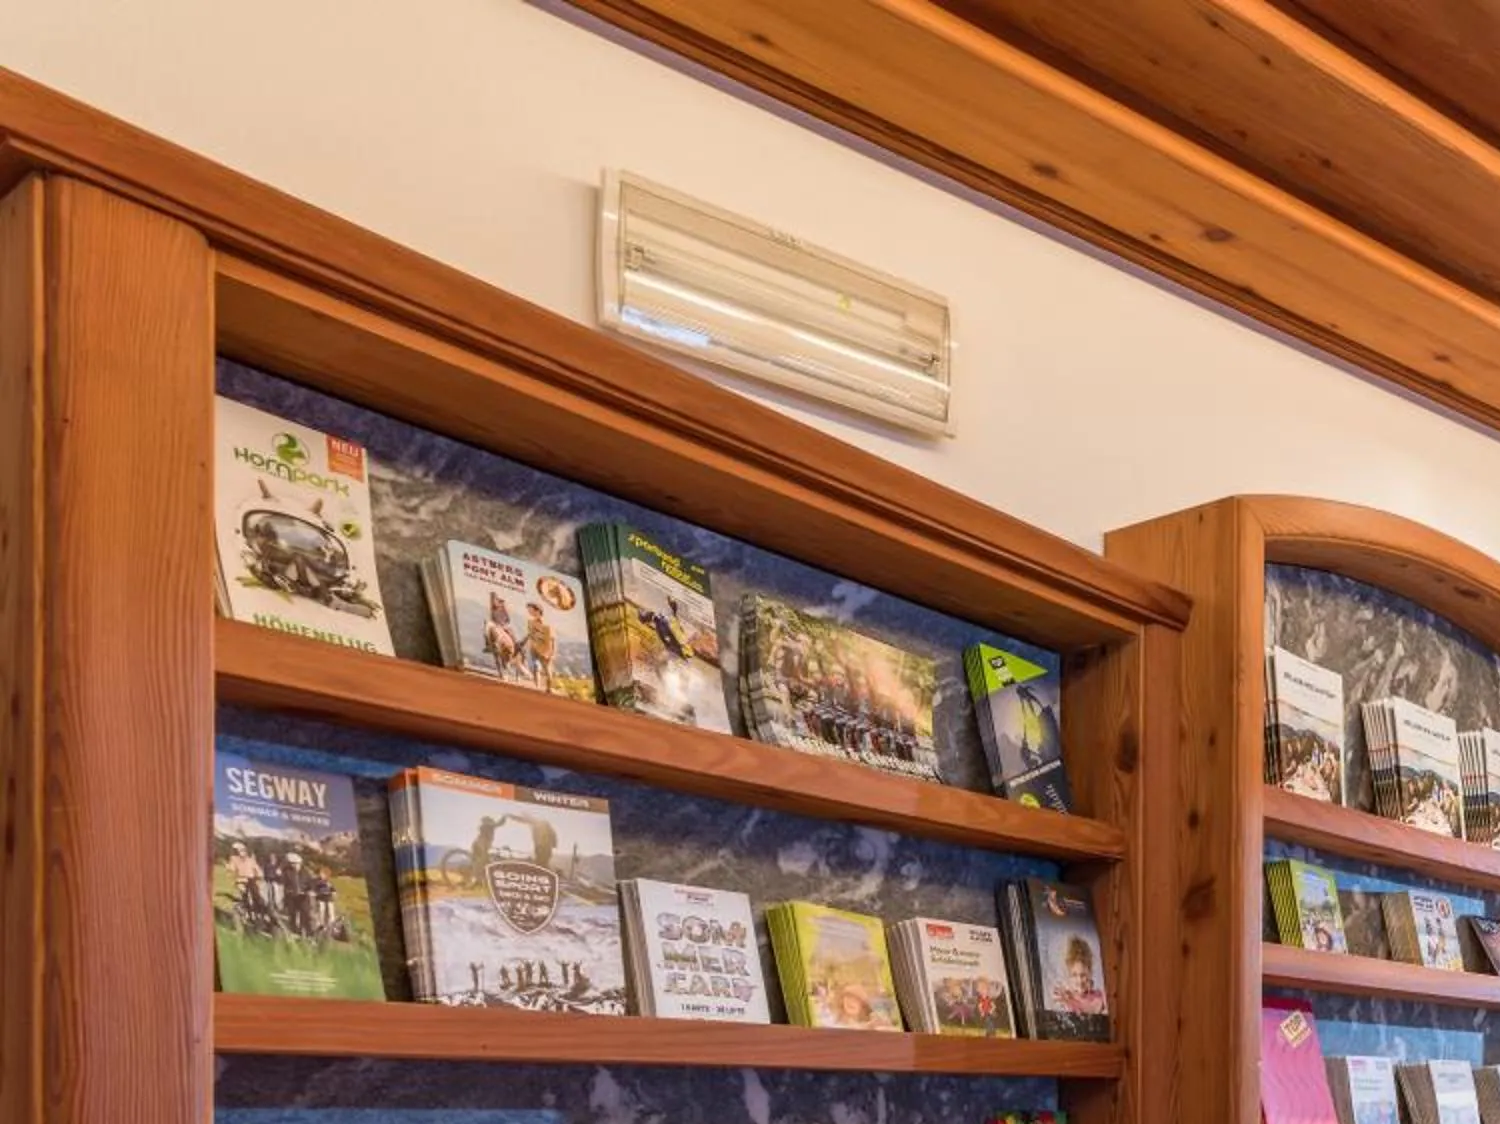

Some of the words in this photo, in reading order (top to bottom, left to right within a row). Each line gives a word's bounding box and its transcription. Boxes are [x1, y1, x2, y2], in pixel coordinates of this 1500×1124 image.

[331, 438, 363, 457] NEU
[233, 447, 350, 497] Hornpark
[226, 767, 326, 809] SEGWAY
[532, 790, 590, 808] WINTER
[656, 912, 747, 948] SOM
[661, 941, 751, 976] MER
[664, 970, 759, 1003] CARD
